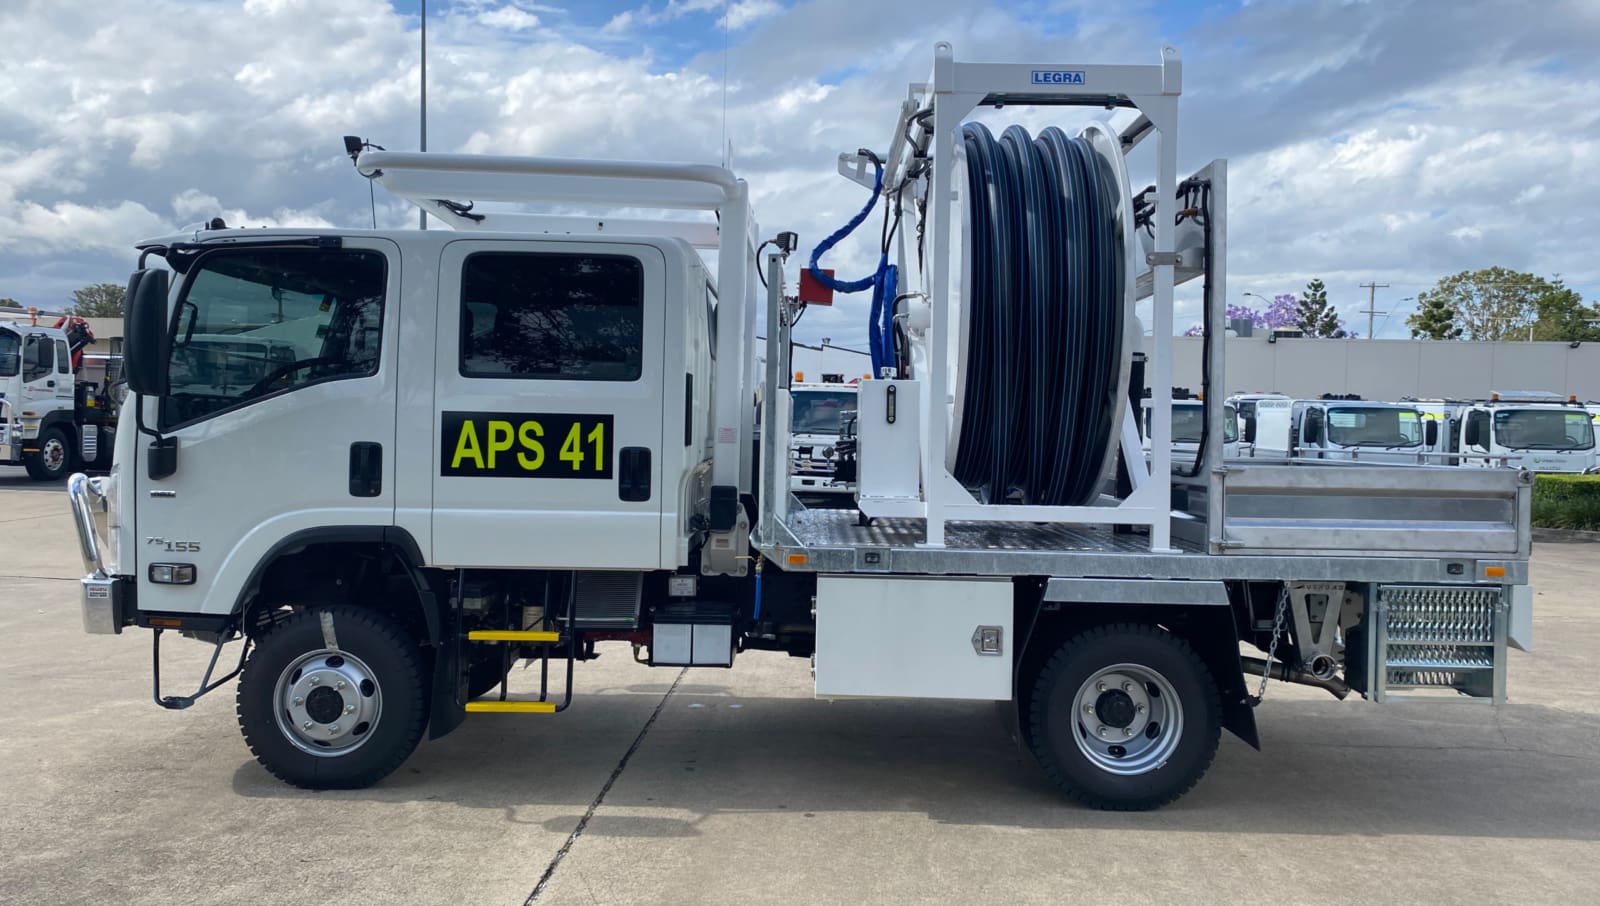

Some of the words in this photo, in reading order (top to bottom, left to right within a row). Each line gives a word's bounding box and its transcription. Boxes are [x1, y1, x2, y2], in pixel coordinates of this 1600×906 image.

[1034, 72, 1083, 84] LEGRA
[450, 420, 546, 470] APS
[559, 422, 604, 471] 41
[164, 541, 201, 552] 155
